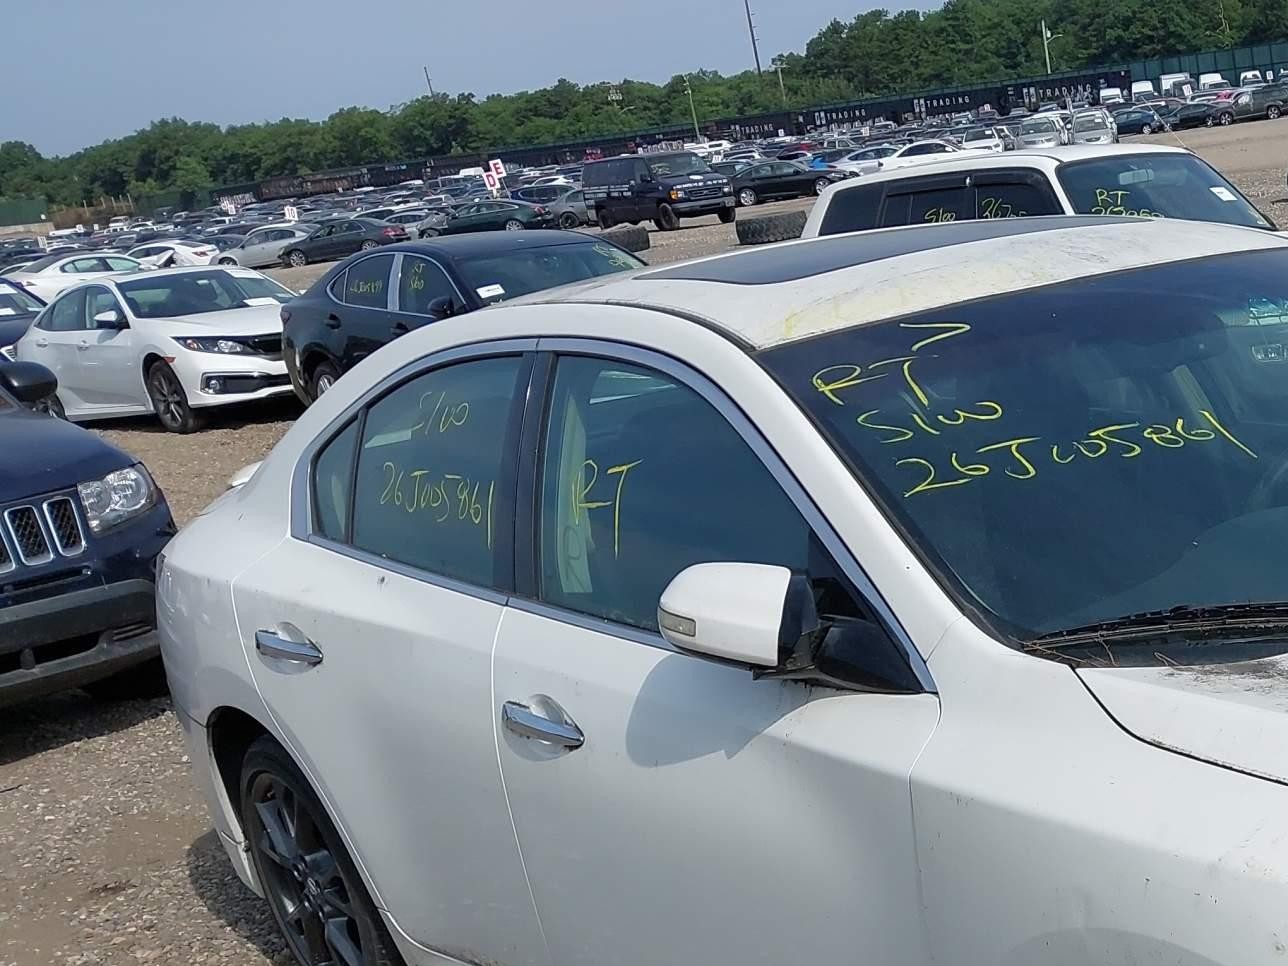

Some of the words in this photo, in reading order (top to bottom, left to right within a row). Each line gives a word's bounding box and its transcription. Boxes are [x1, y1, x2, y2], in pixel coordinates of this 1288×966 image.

[1039, 84, 1092, 98] TRADING
[927, 96, 970, 108] TRADING
[826, 109, 866, 121] TRADING
[740, 123, 774, 135] TRADING
[492, 162, 504, 175] E
[485, 174, 497, 187] D
[1095, 188, 1131, 206] RT
[812, 355, 939, 409] RT
[571, 459, 645, 561] RT
